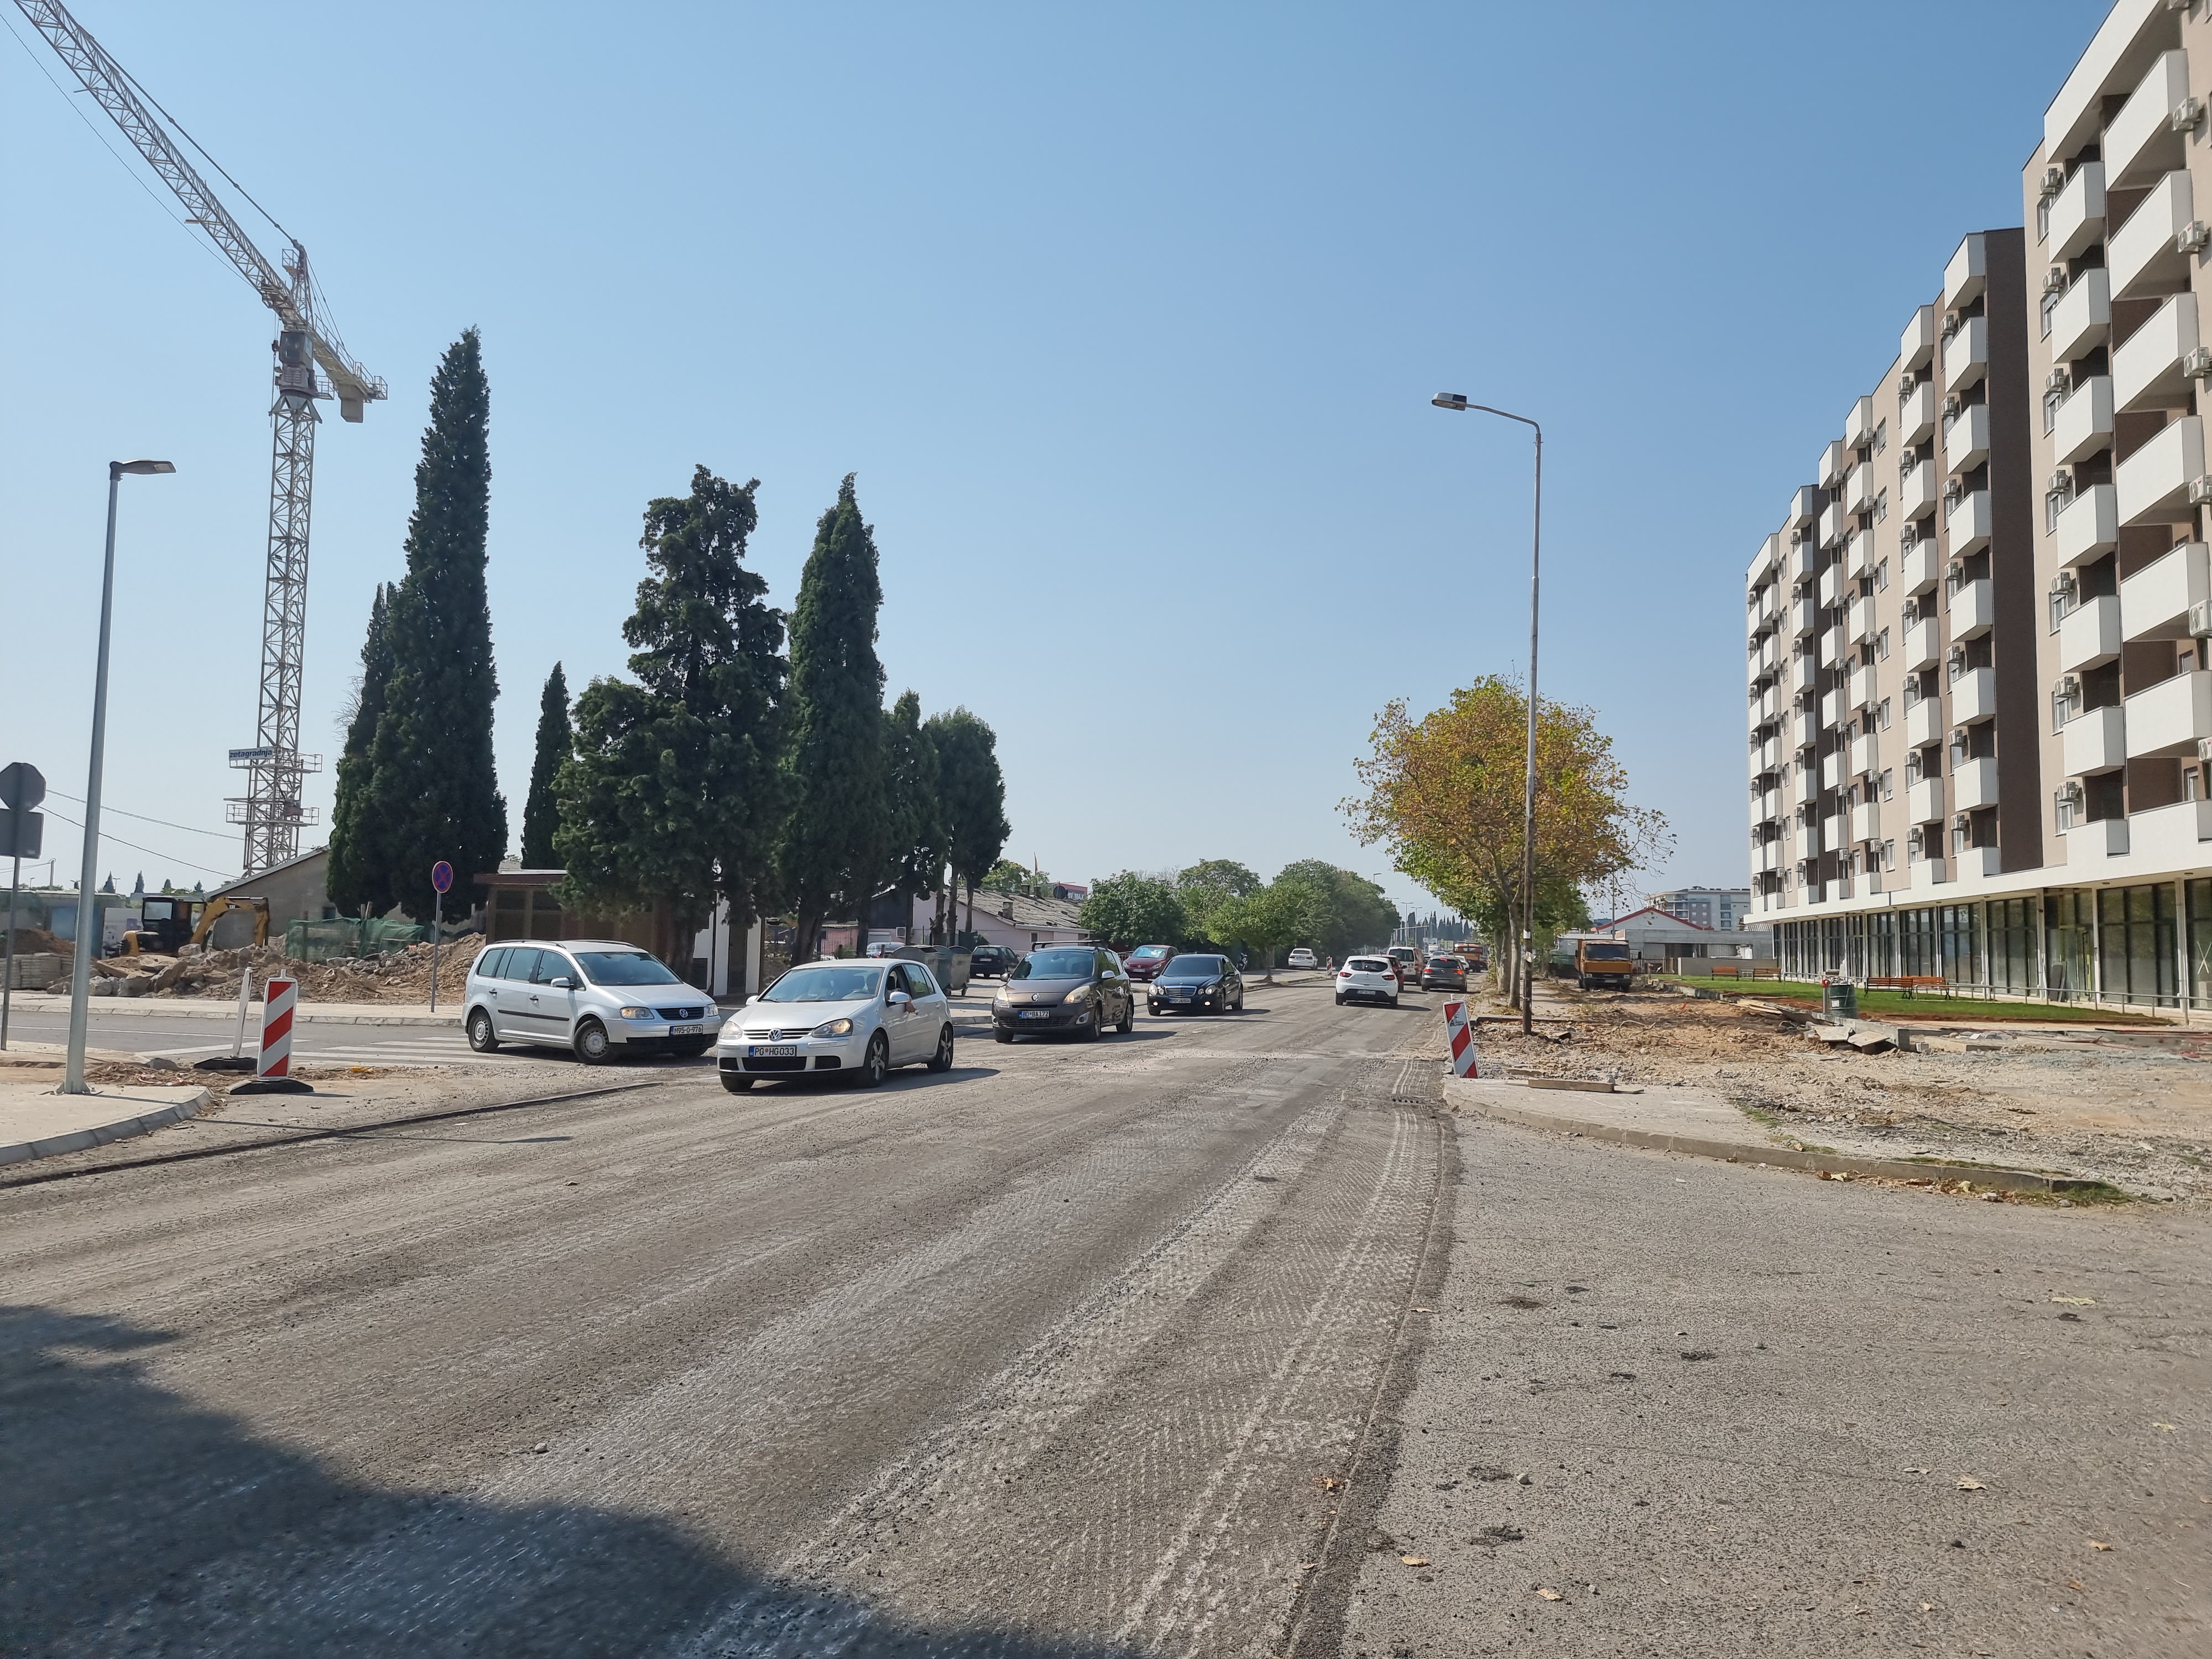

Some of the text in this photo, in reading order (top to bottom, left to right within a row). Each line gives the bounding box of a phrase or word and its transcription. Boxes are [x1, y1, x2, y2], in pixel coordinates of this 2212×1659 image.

[229, 749, 272, 758] zetagradnja
[755, 1047, 794, 1056] PG HG033
